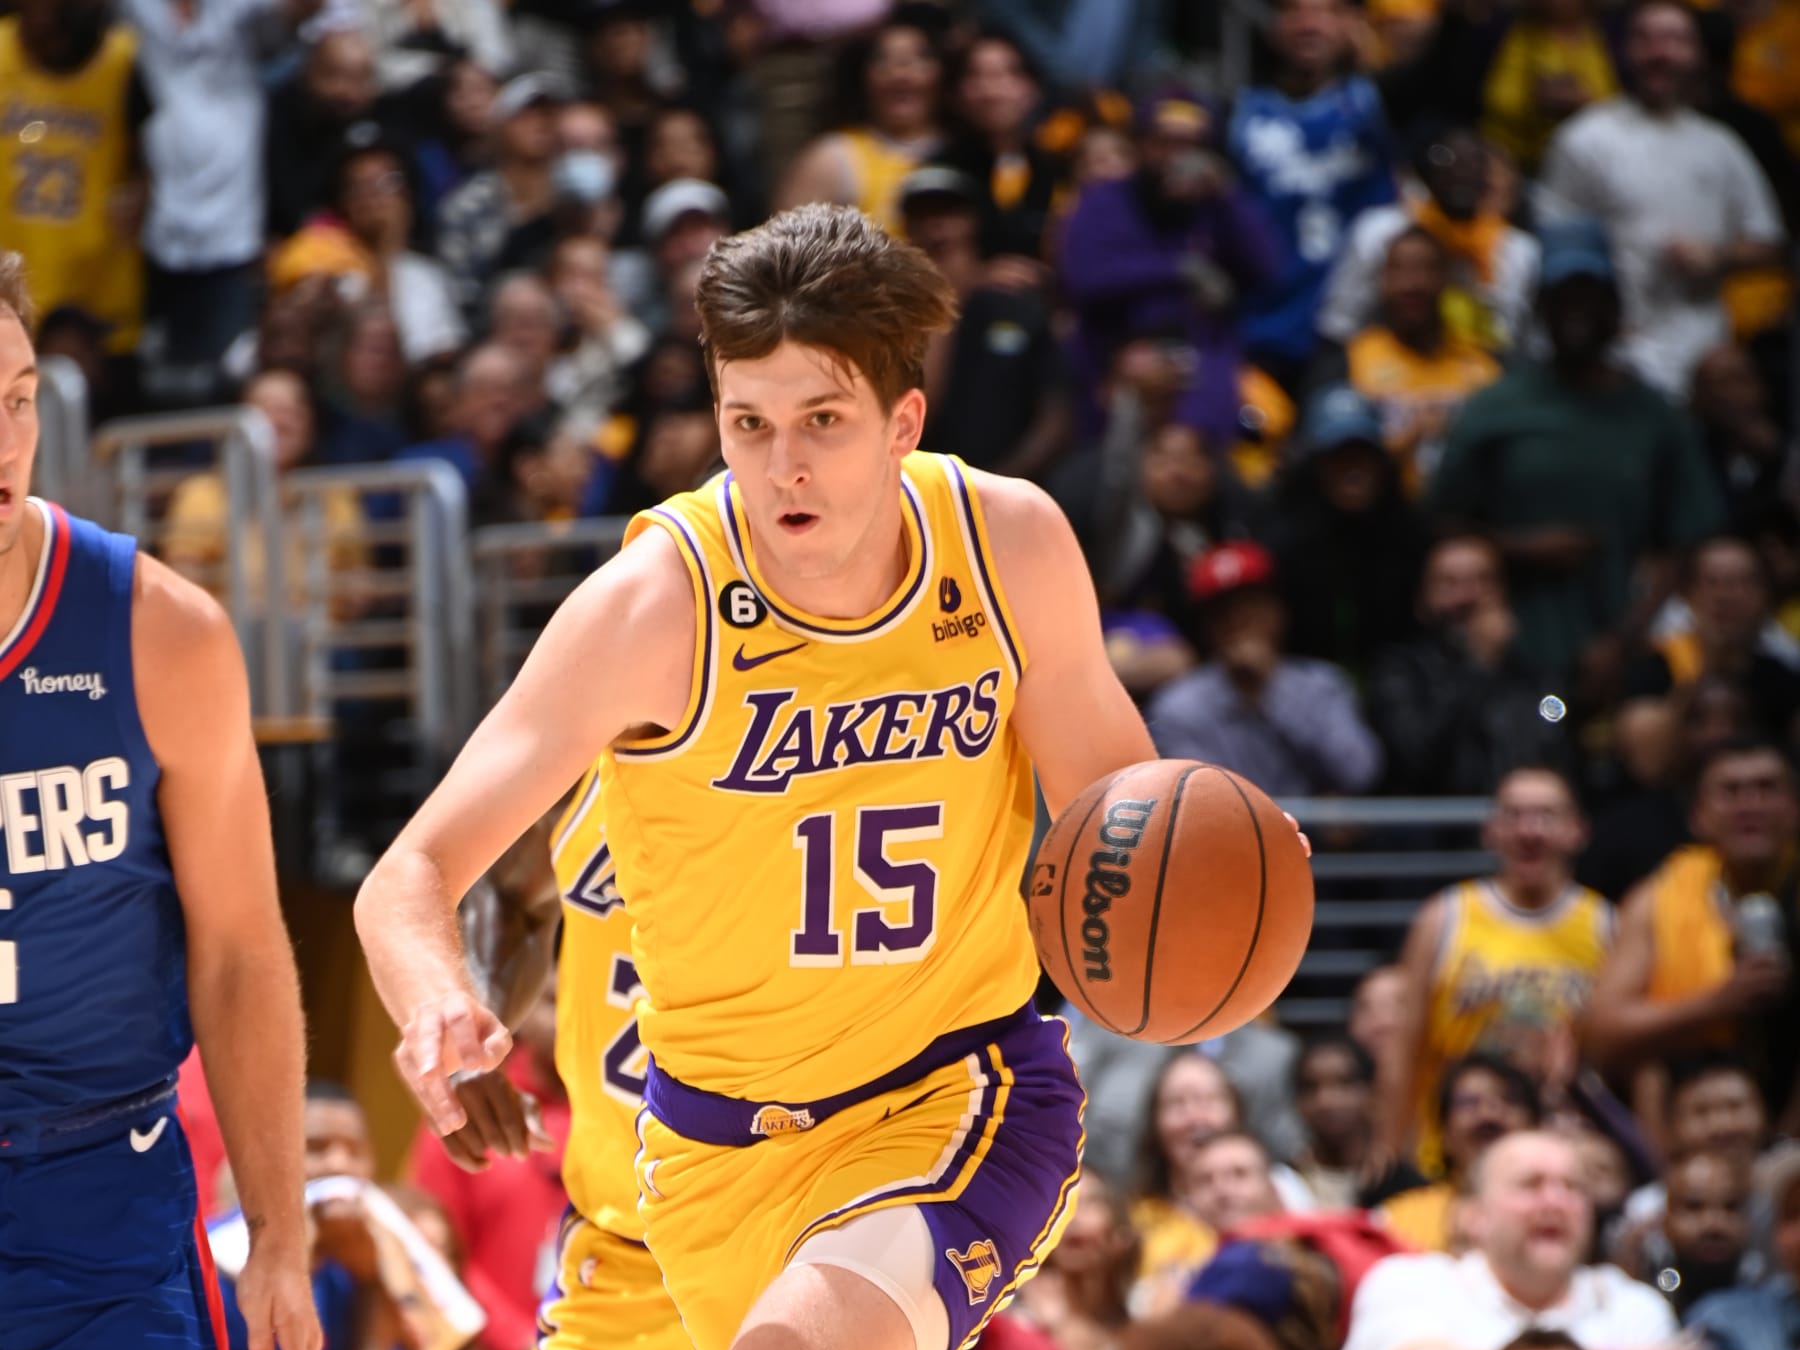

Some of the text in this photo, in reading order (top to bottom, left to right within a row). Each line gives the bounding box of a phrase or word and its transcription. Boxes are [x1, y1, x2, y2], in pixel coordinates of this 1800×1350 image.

[730, 587, 758, 624] 6
[931, 611, 987, 643] bibigo
[19, 666, 108, 700] honey
[710, 668, 1002, 795] LAKERS
[0, 756, 130, 874] ERS
[789, 801, 945, 968] 15
[1081, 798, 1158, 983] Wilson
